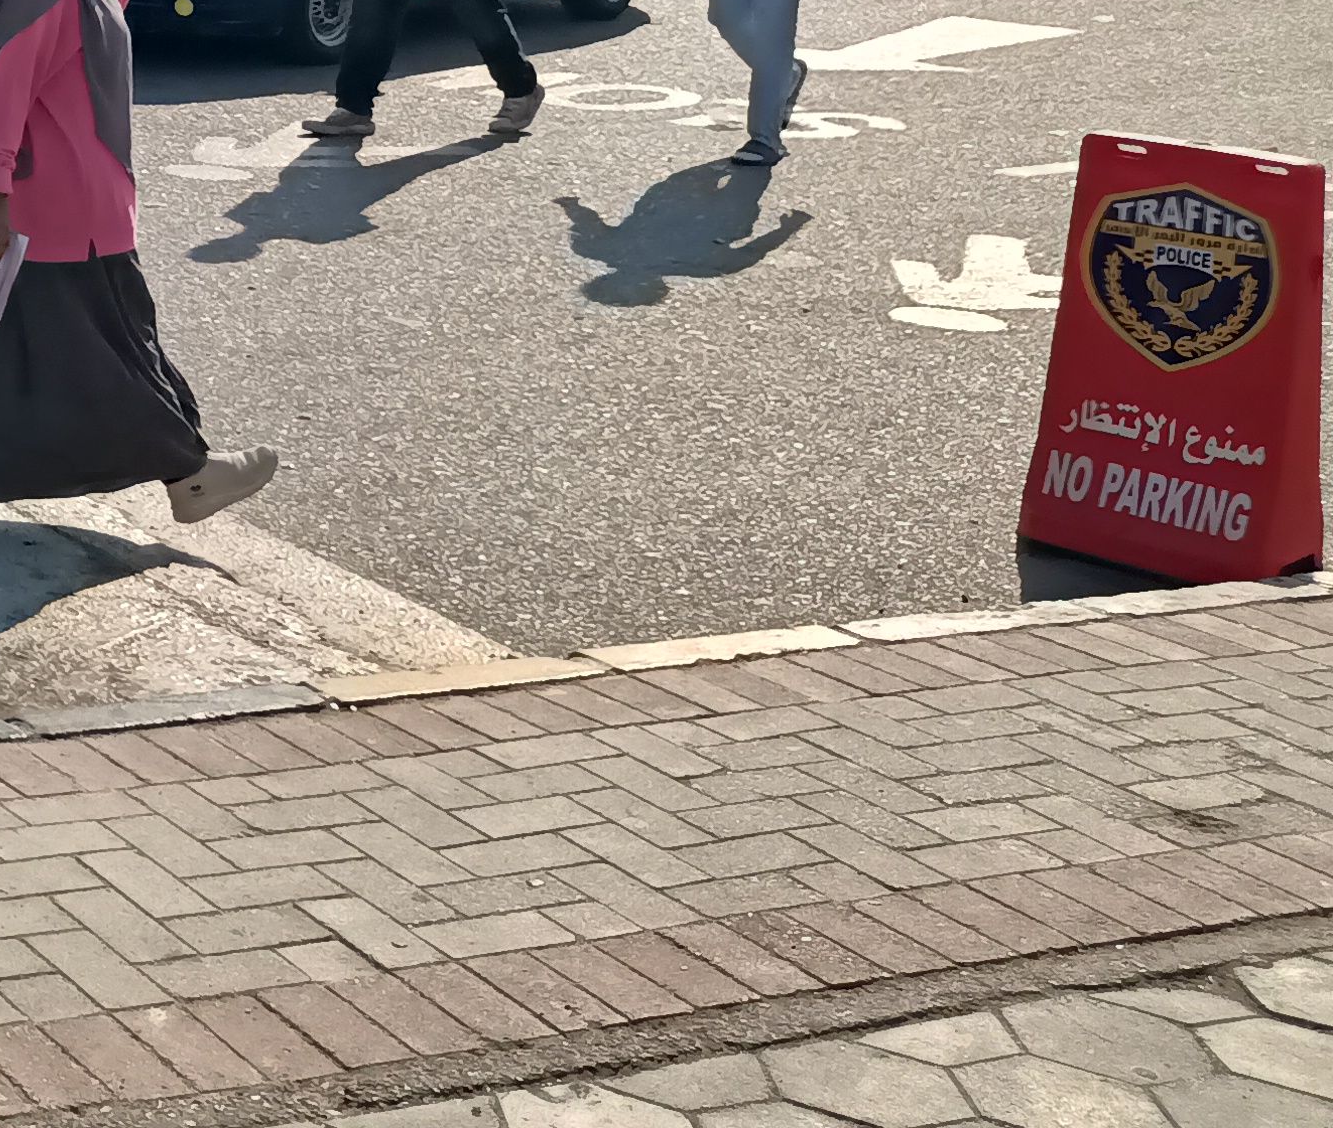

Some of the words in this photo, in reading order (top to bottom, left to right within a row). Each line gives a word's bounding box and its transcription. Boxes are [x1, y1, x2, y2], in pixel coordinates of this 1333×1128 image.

[1113, 196, 1257, 241] TRAFFIC
[1156, 246, 1212, 269] POLICE
[1182, 425, 1266, 466] ممنوع
[1042, 449, 1093, 502] NO
[1097, 462, 1253, 541] PARKING
